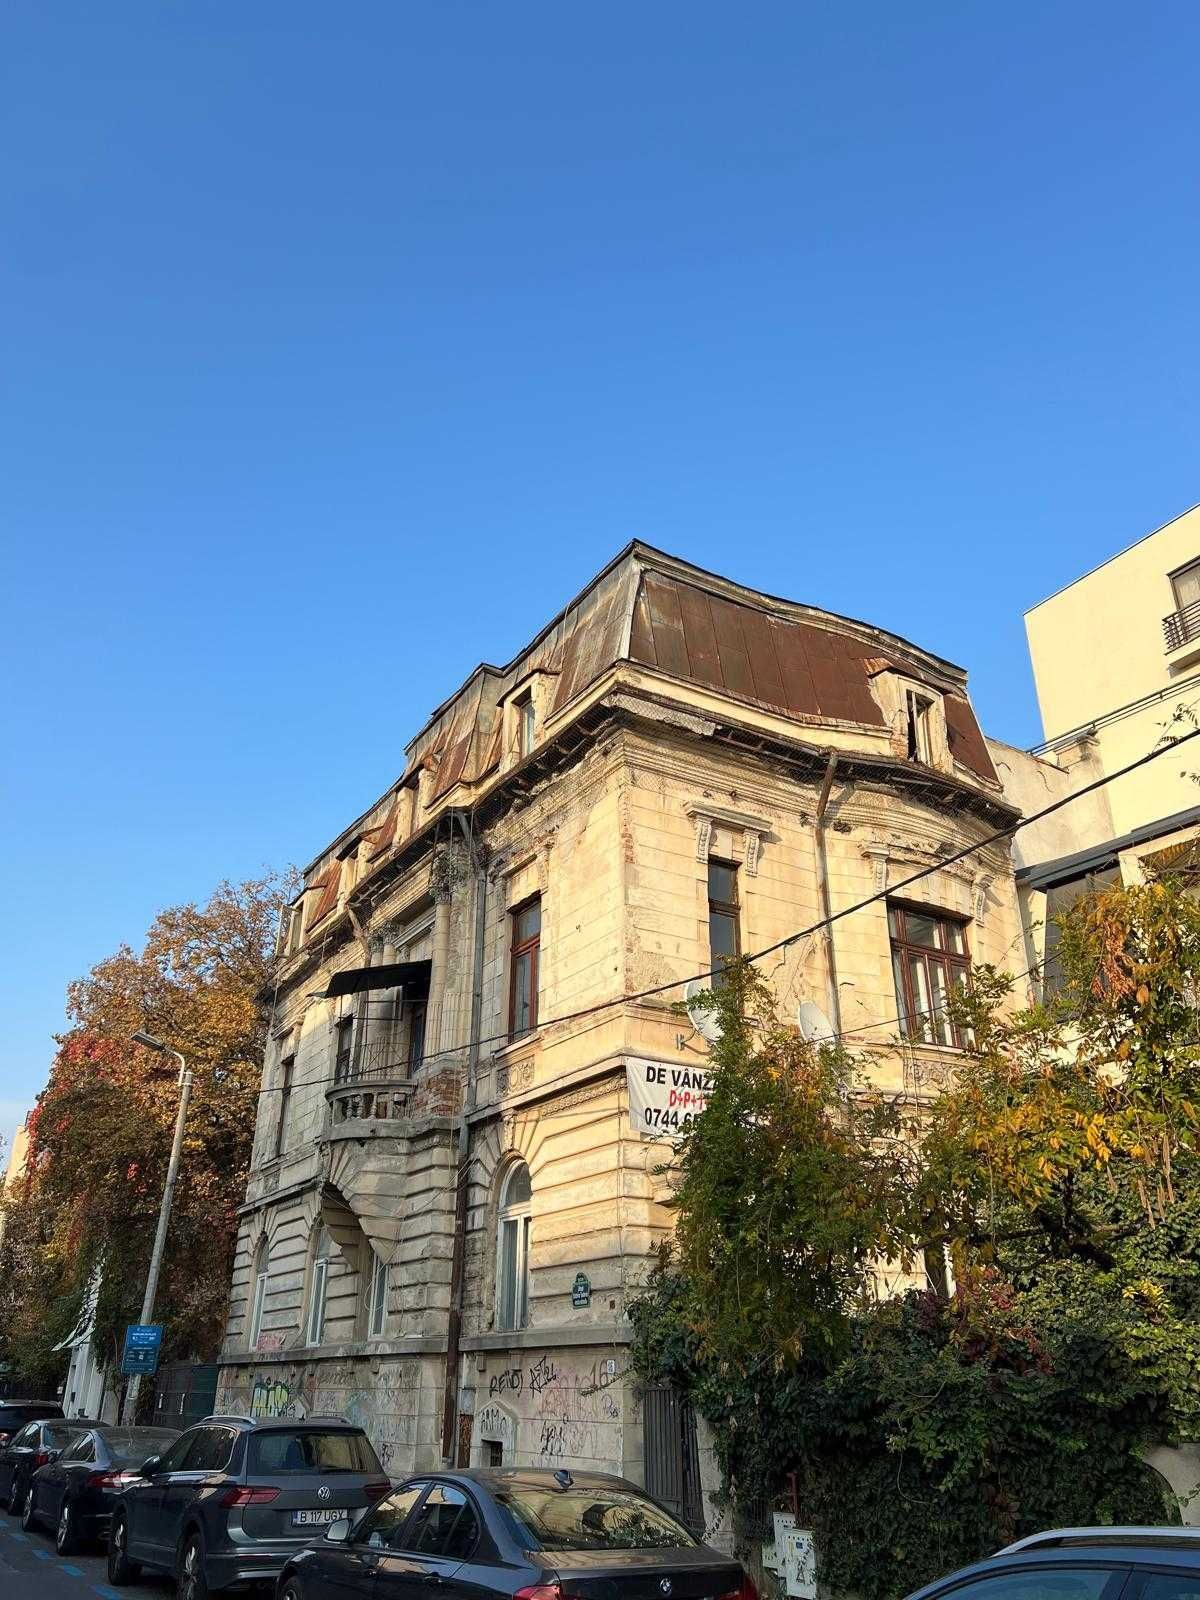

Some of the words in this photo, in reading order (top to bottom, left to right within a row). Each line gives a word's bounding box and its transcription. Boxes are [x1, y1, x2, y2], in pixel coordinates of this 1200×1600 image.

[646, 1066, 667, 1085] DE
[644, 1107, 679, 1128] 0744
[300, 1511, 307, 1523] B
[311, 1511, 322, 1523] 117
